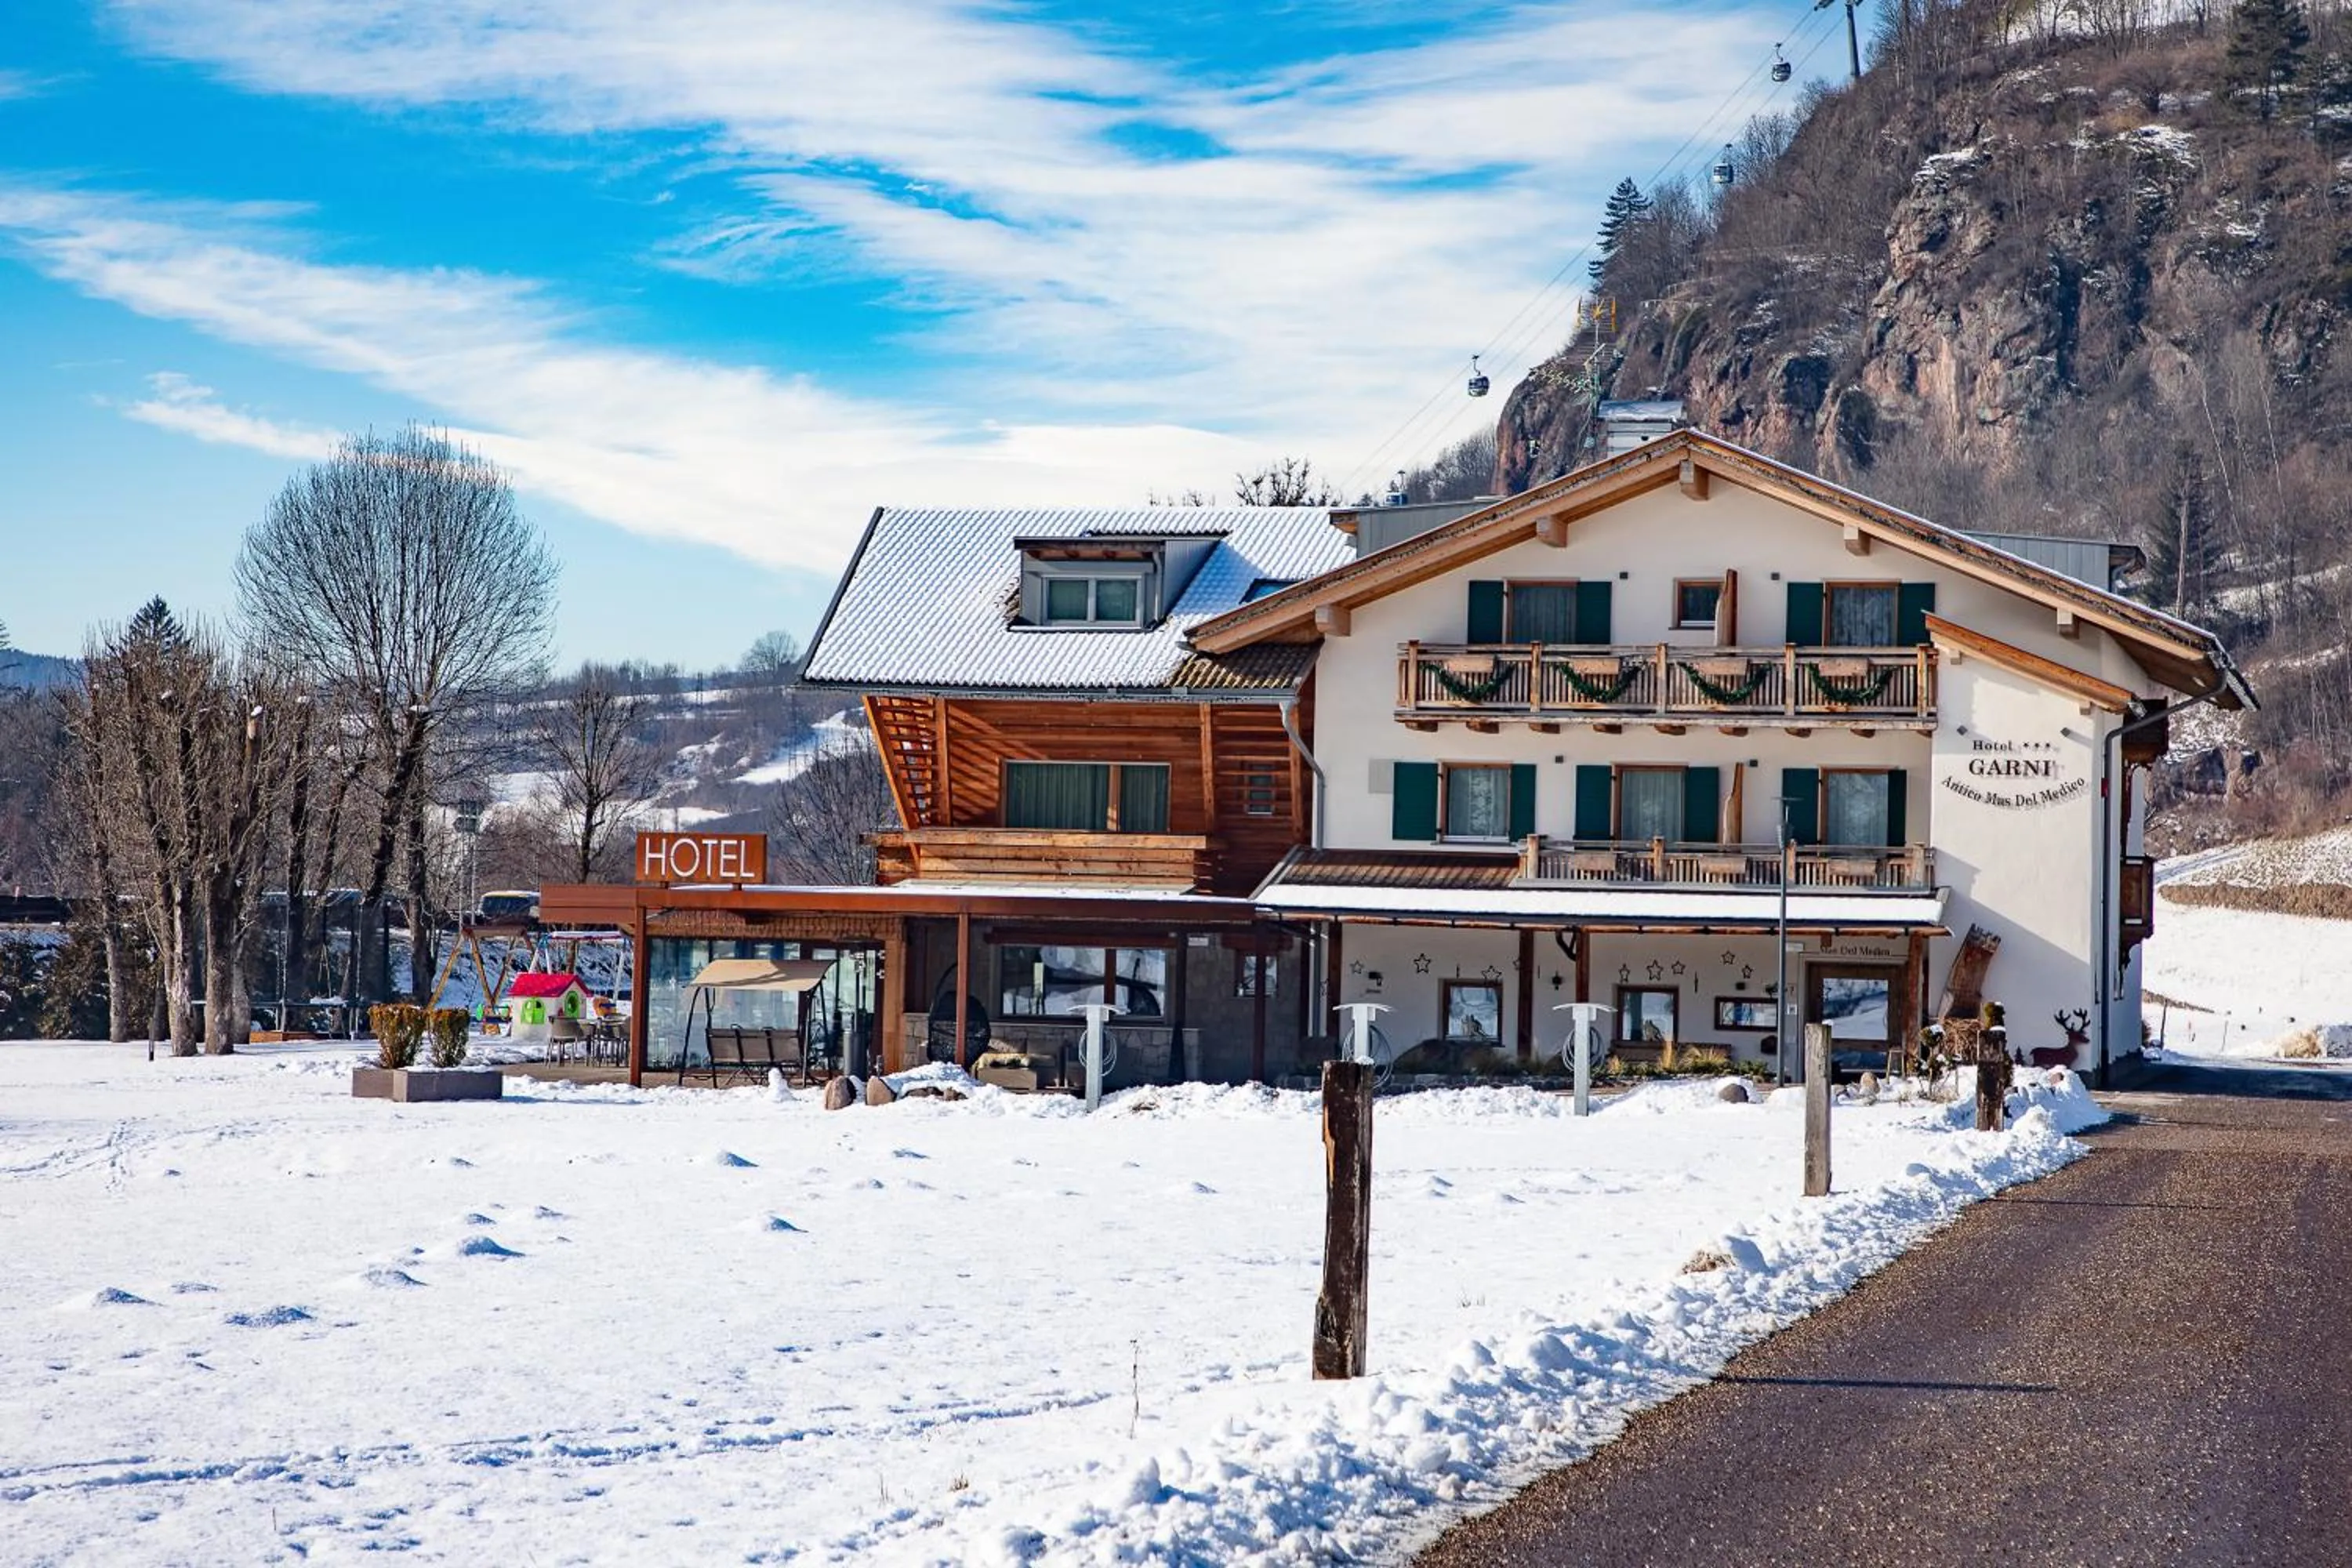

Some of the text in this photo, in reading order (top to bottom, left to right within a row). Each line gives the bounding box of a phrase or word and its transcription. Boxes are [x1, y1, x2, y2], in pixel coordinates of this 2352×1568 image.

[1973, 740, 2013, 751] Hotel
[1941, 775, 1981, 801] Antico
[2016, 793, 2037, 807] Del
[2040, 777, 2085, 804] Medico
[645, 838, 755, 877] HOTEL
